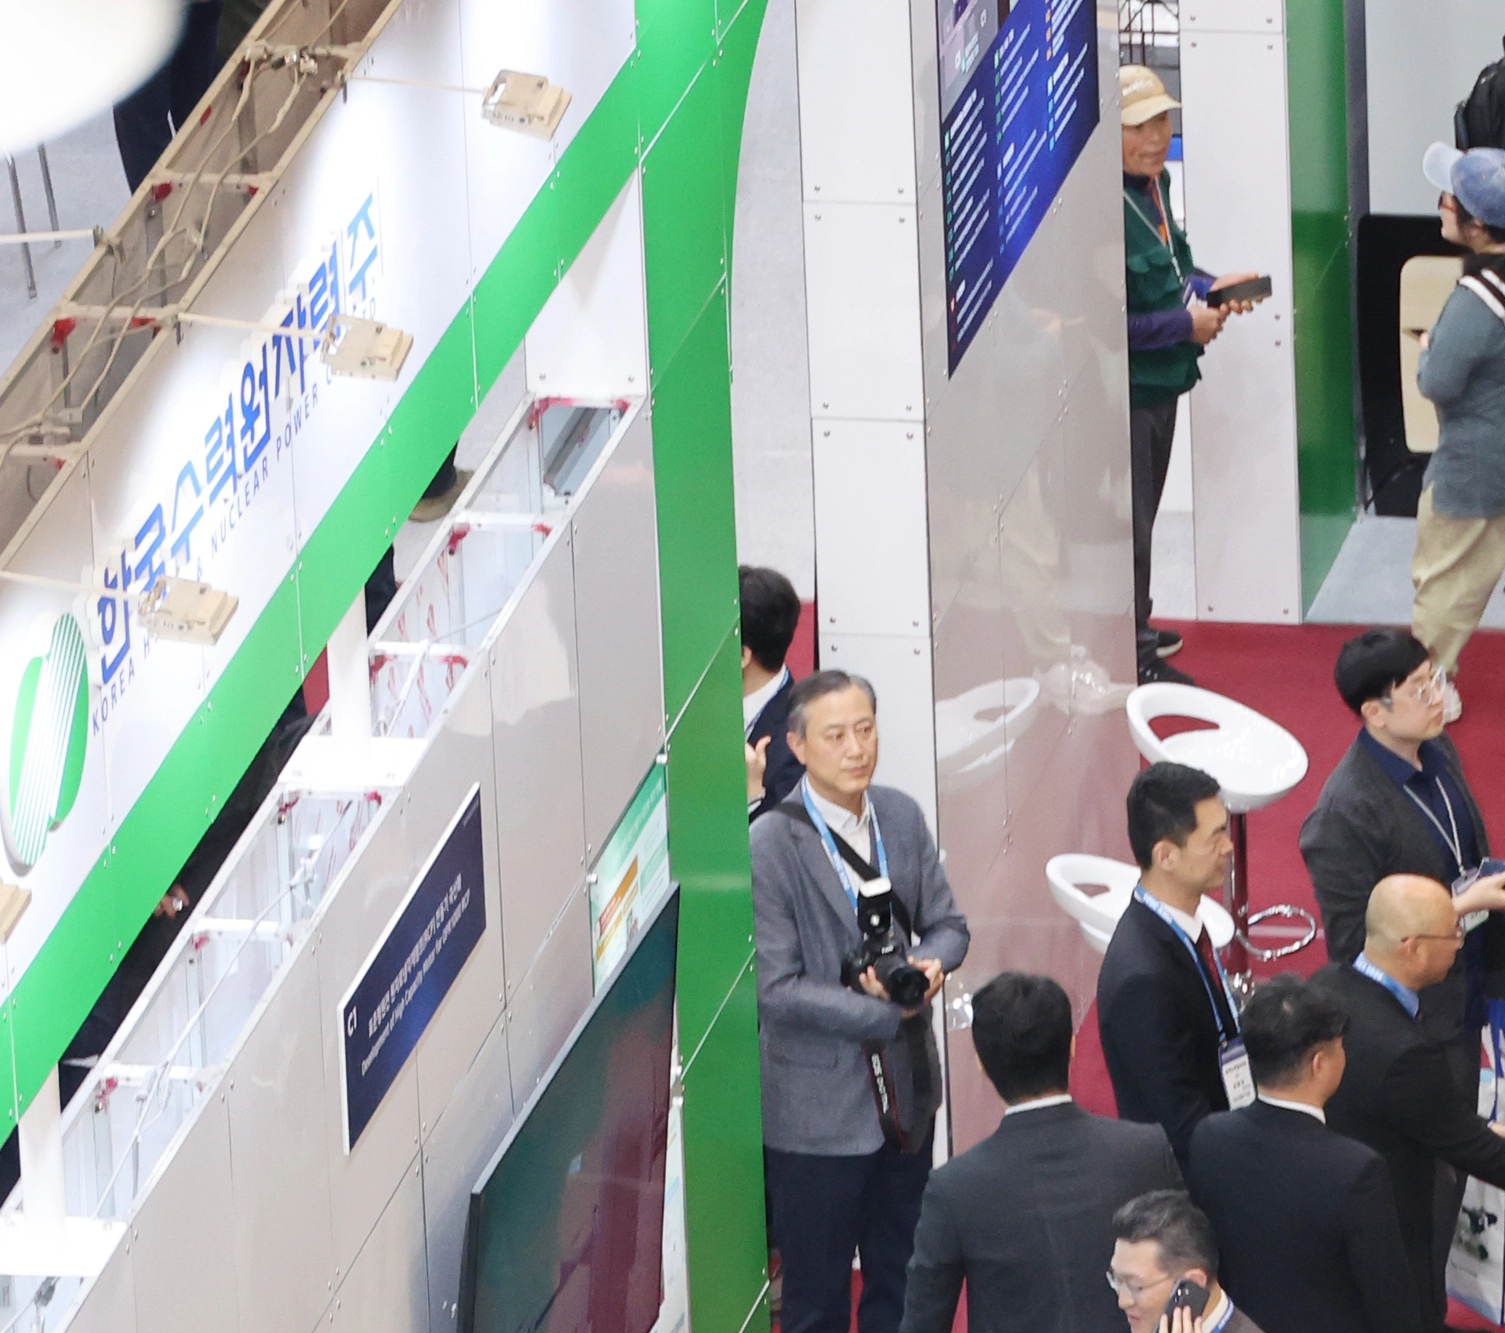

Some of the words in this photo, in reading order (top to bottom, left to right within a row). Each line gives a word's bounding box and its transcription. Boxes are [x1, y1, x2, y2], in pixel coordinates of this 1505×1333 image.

[92, 656, 135, 737] KOREA
[211, 455, 268, 560] NUCLEAR
[275, 381, 319, 463] POWER
